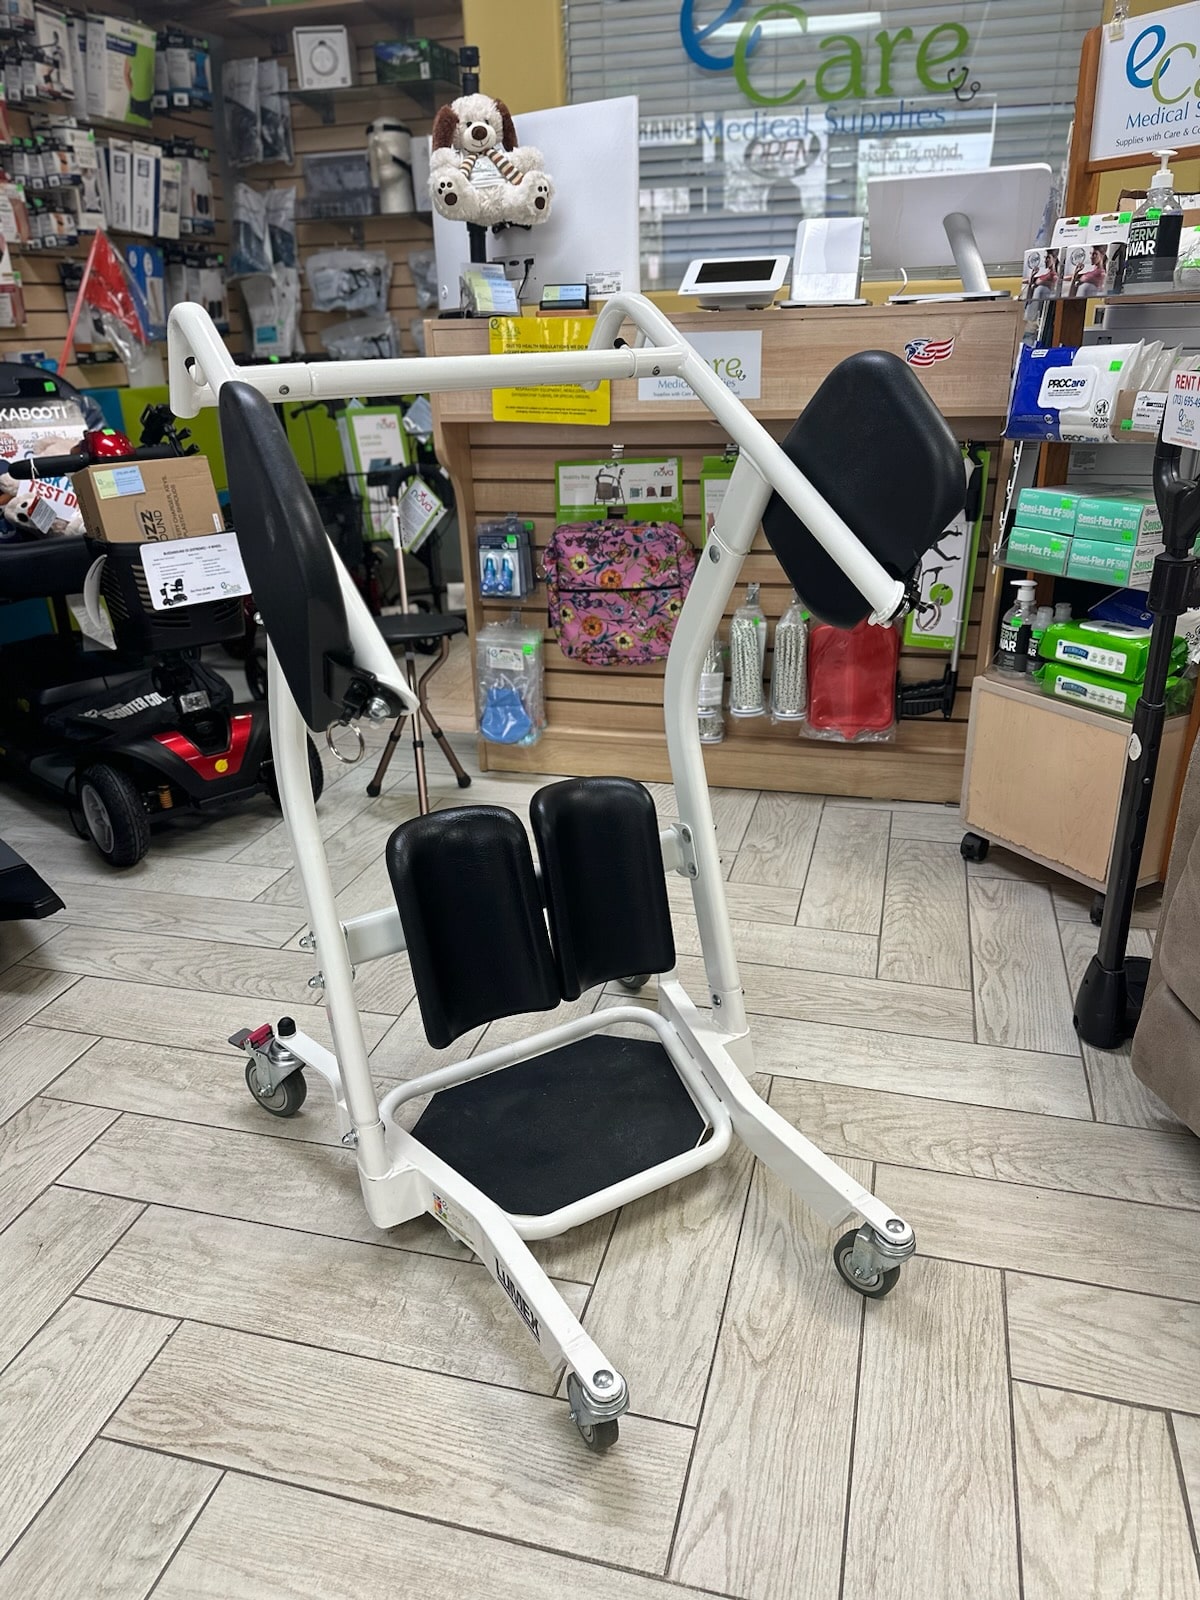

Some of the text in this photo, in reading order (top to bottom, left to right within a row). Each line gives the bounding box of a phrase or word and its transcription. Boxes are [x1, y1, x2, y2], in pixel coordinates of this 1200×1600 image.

[701, 101, 946, 143] Medical Supplies
[1126, 101, 1189, 130] Medical
[1115, 136, 1144, 147] Supplies
[1146, 131, 1161, 142] with
[1163, 130, 1180, 139] Care
[1183, 128, 1189, 136] &
[1048, 379, 1086, 389] PROCare
[1174, 374, 1197, 392] RENT
[29, 480, 64, 502] TEST
[1078, 513, 1113, 527] Sensi-Flex
[101, 696, 149, 720] SCOOTER
[495, 1256, 540, 1338] LUMEX
